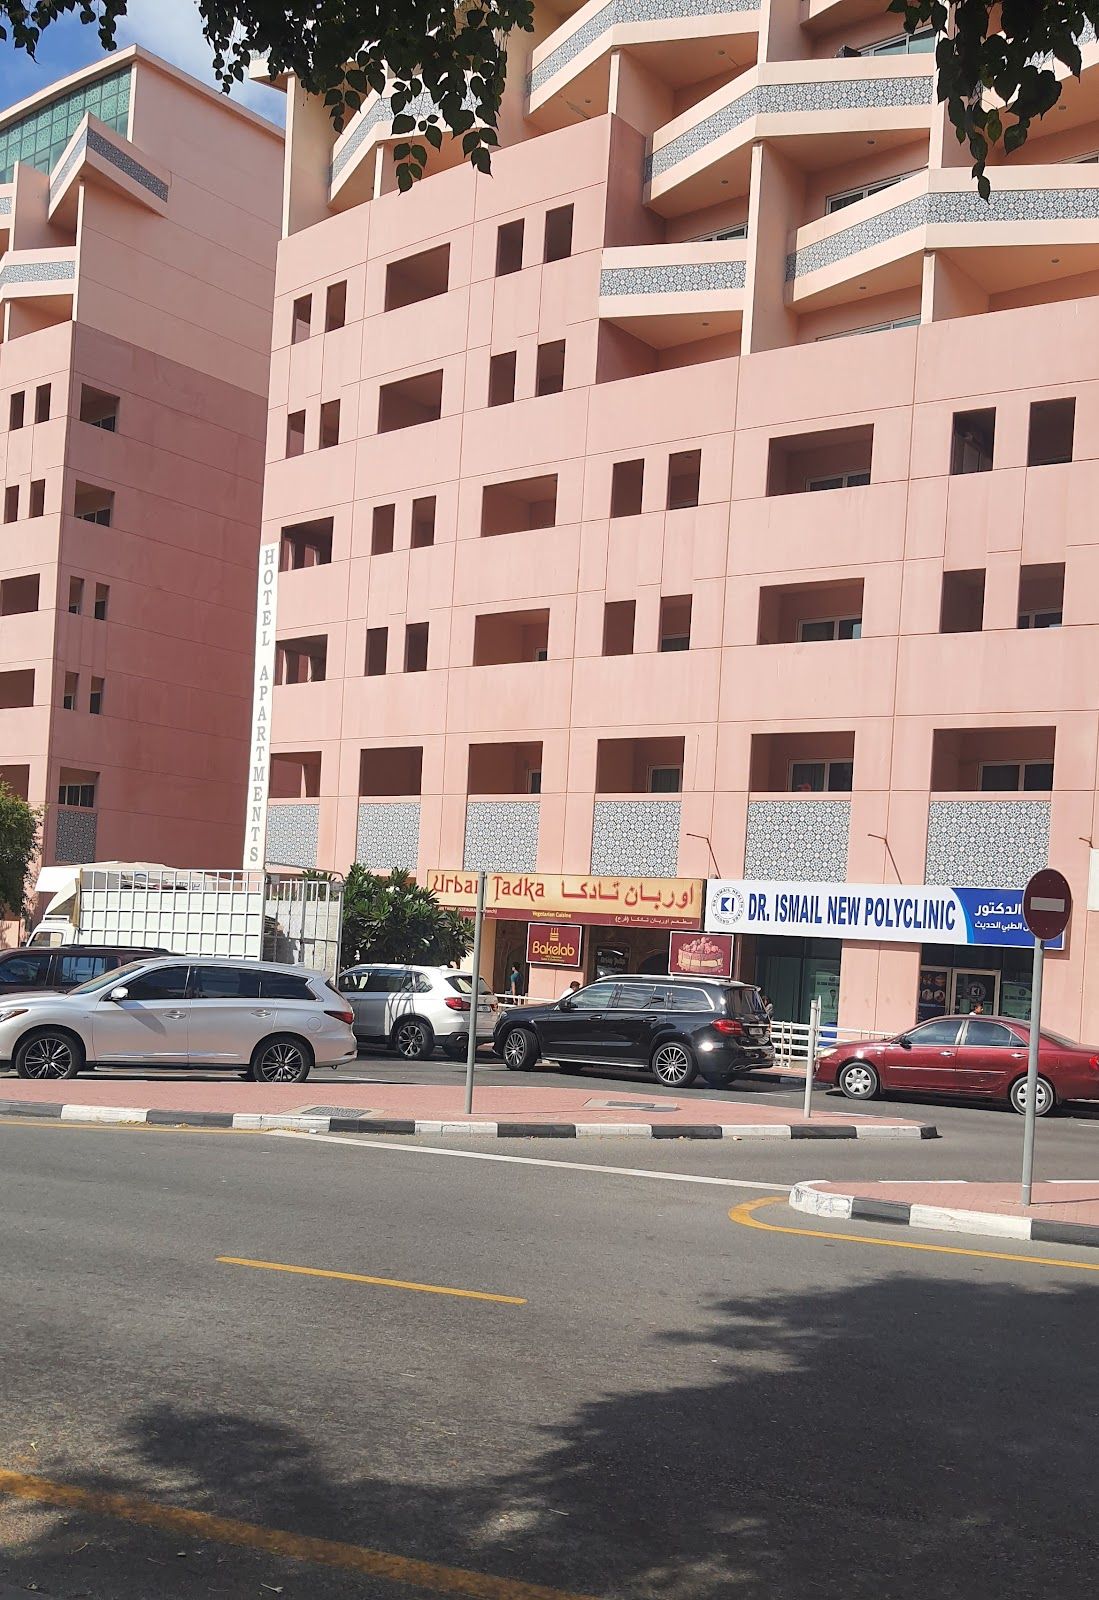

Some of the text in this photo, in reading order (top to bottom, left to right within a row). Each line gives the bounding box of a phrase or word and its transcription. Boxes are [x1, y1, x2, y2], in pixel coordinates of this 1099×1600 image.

[249, 548, 275, 862] HOTEL APARTMENTS
[492, 875, 545, 901] Tadka
[561, 880, 693, 910] اوربان تادكا
[748, 893, 956, 930] DR. ISMAIL NEW POLYCLINIC
[974, 902, 1021, 916] الدكتور
[974, 921, 1001, 930] الحديث
[1001, 922, 1023, 932] الطبي
[532, 941, 575, 957] Bakelab
